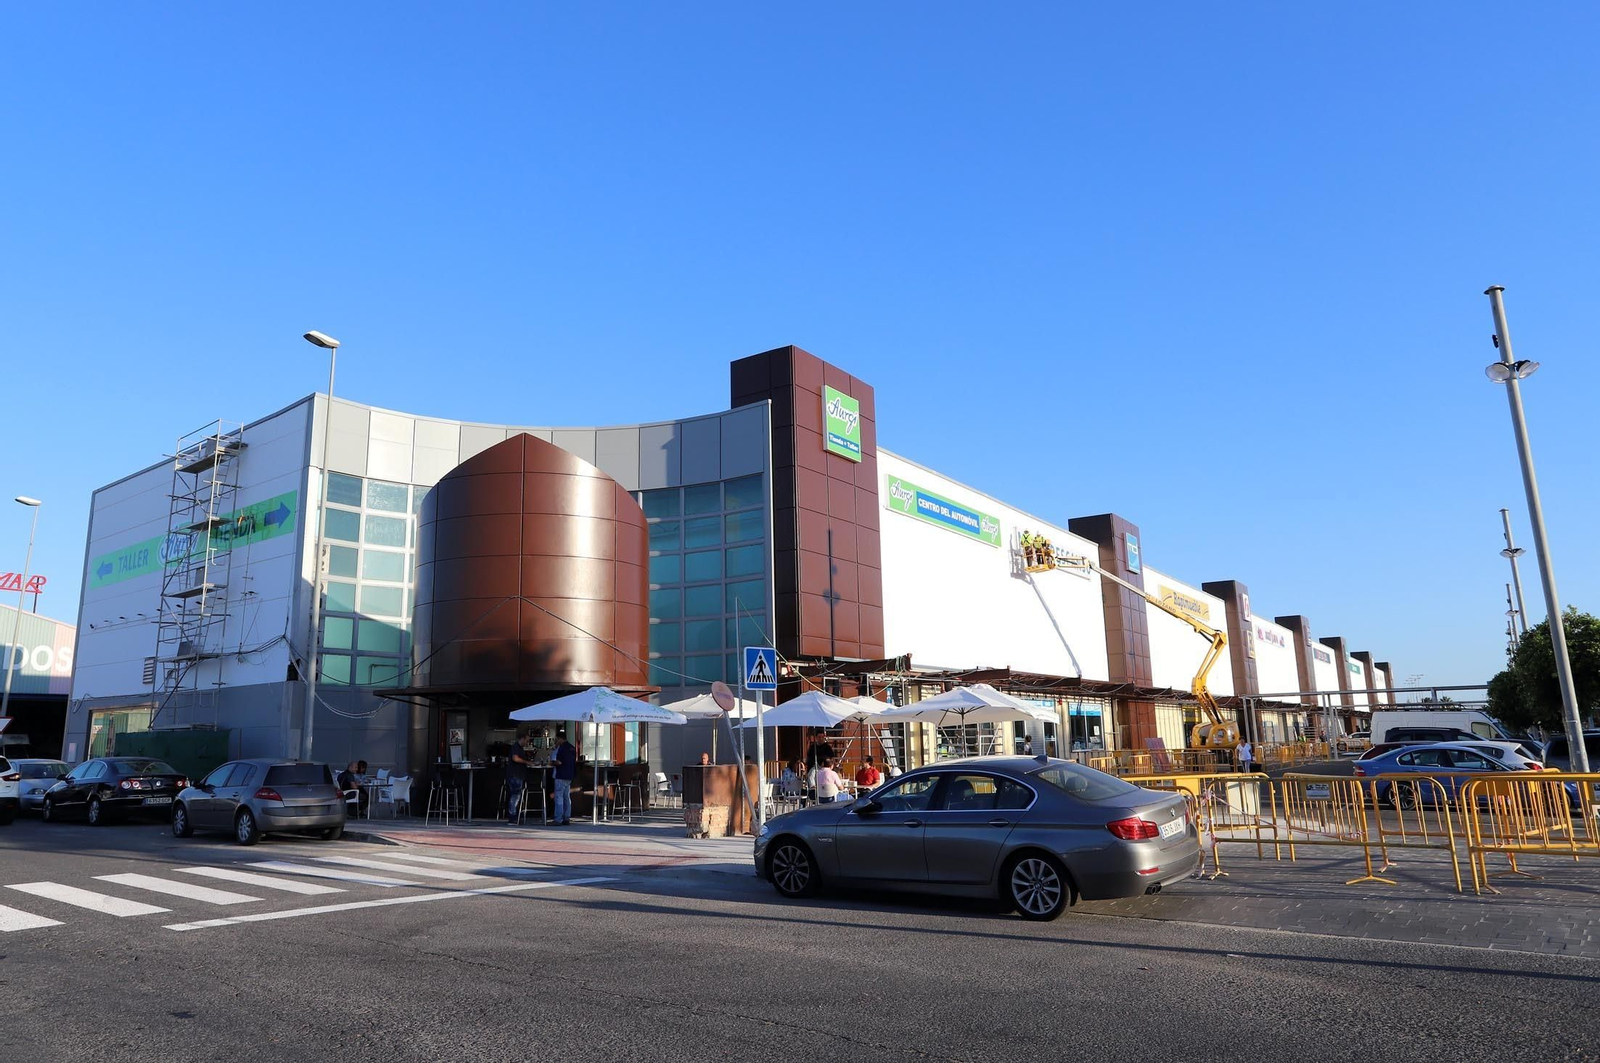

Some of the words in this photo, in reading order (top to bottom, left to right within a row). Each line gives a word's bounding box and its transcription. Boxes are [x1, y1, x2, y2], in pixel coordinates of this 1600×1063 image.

[827, 397, 859, 435] Aurgi
[890, 480, 913, 511] Aurgi
[918, 498, 941, 514] CENTRO
[941, 506, 951, 518] DEL
[952, 510, 979, 528] AUTOMÓVIL
[981, 516, 999, 542] Aurgi
[118, 548, 149, 575] TALLER
